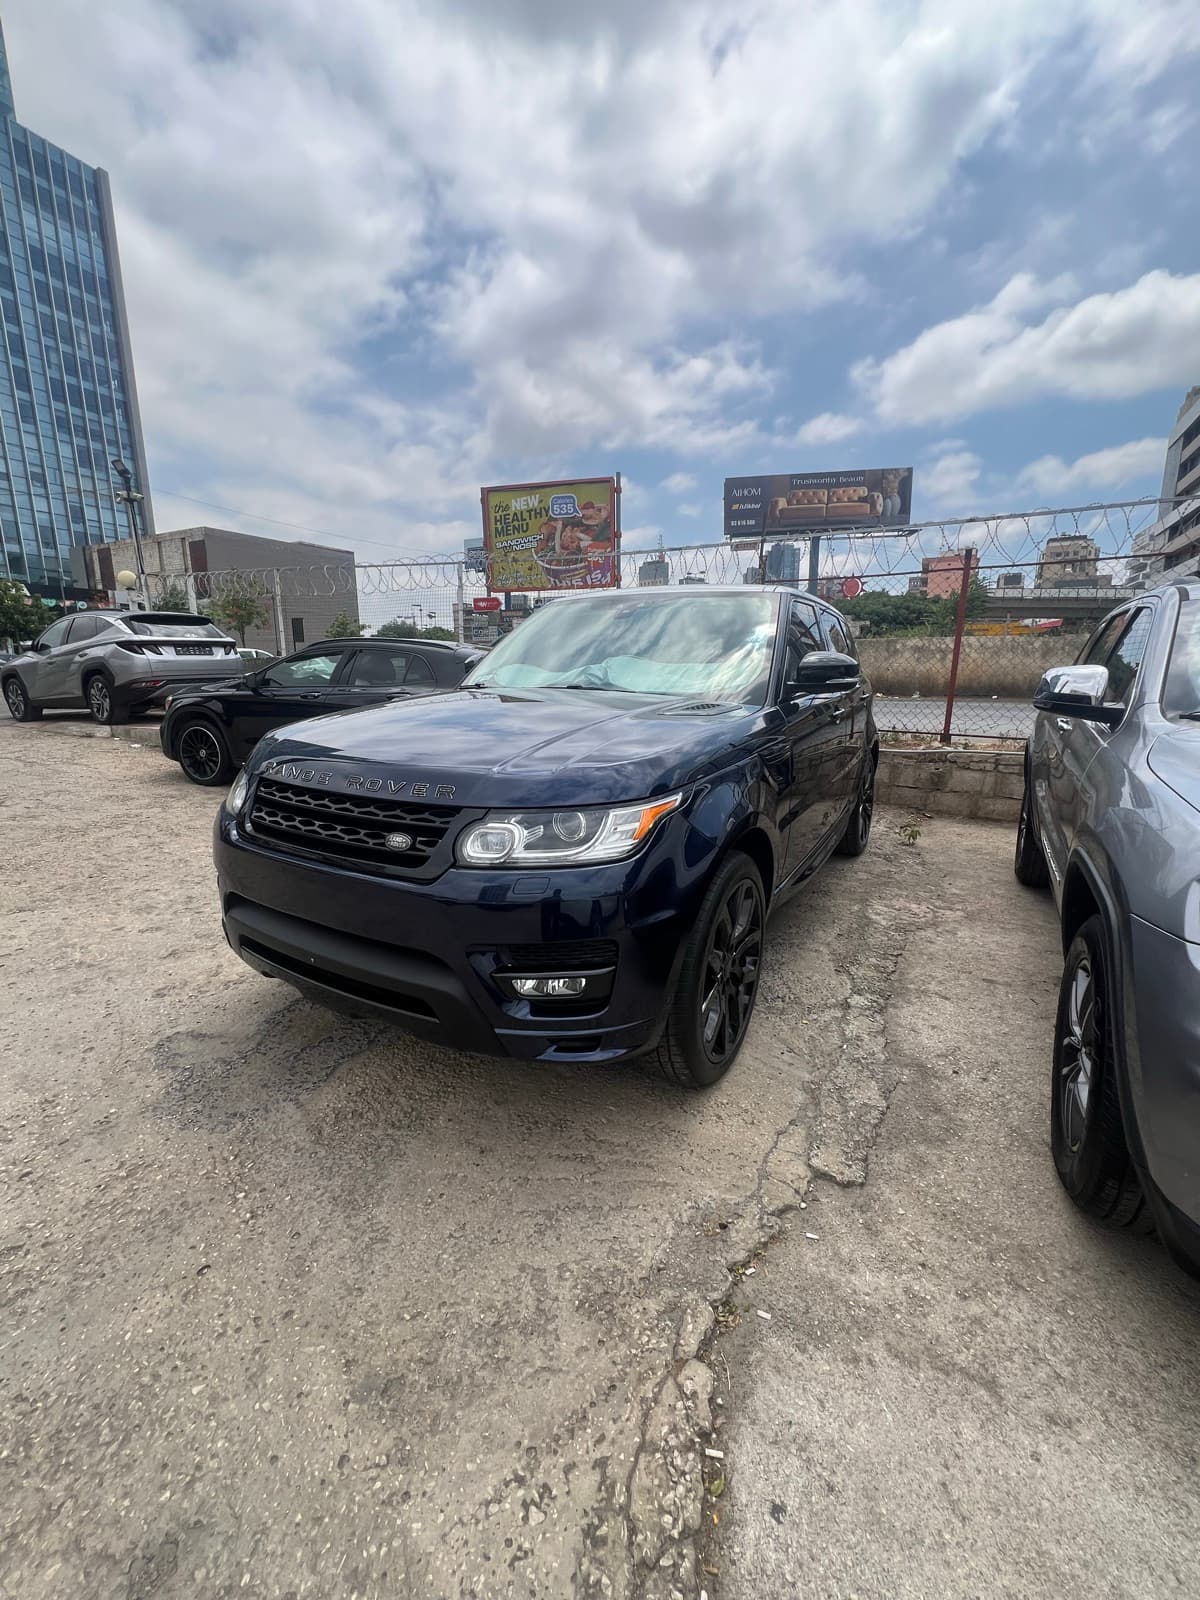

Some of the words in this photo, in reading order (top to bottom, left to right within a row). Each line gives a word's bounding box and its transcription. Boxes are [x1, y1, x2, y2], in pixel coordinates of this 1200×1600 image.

[494, 500, 511, 514] the
[512, 495, 540, 511] NEW
[553, 503, 574, 514] 535
[494, 506, 550, 526] HEALTHY
[495, 522, 529, 538] MENU
[495, 534, 544, 549] SANDWICH
[263, 761, 333, 785] RANGE
[347, 775, 457, 800] ROVER
